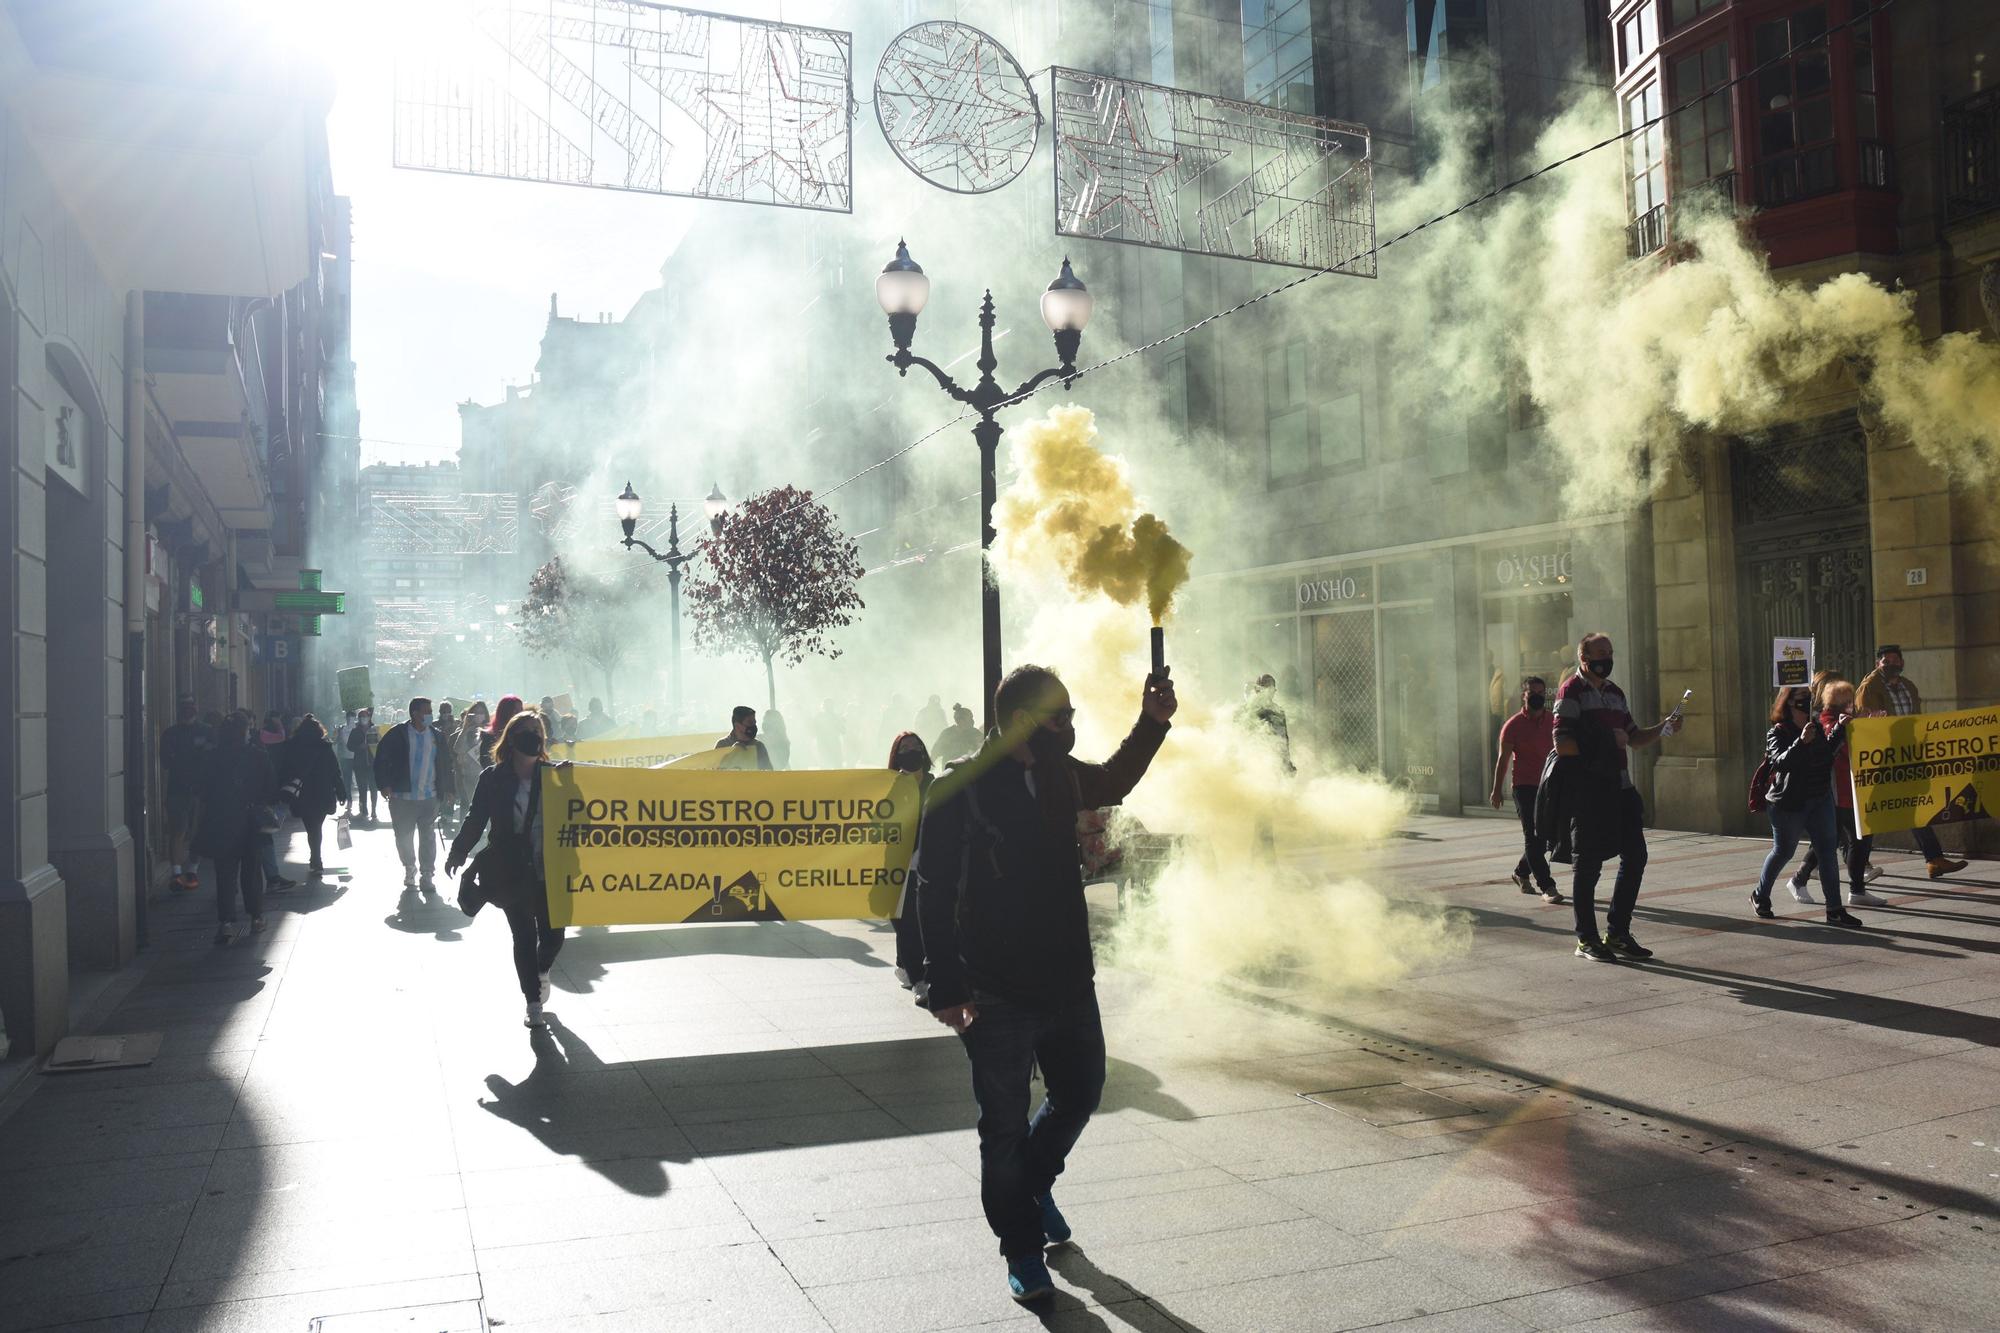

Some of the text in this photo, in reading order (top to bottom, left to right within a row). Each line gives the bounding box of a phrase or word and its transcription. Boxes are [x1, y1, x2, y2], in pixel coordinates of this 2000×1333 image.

[1497, 552, 1572, 583] OYSHO
[1298, 577, 1356, 604] OYSHO
[1926, 714, 1998, 732] LA CAMOCHA
[1859, 735, 1999, 768] POR NUESTRO F
[567, 798, 896, 823] POR NUESTRO FUTURO
[1865, 795, 1934, 813] LA PEDRERA
[557, 823, 902, 848] #todossomoshosteleria
[566, 868, 905, 893] LA CALZADA CERILLERO
